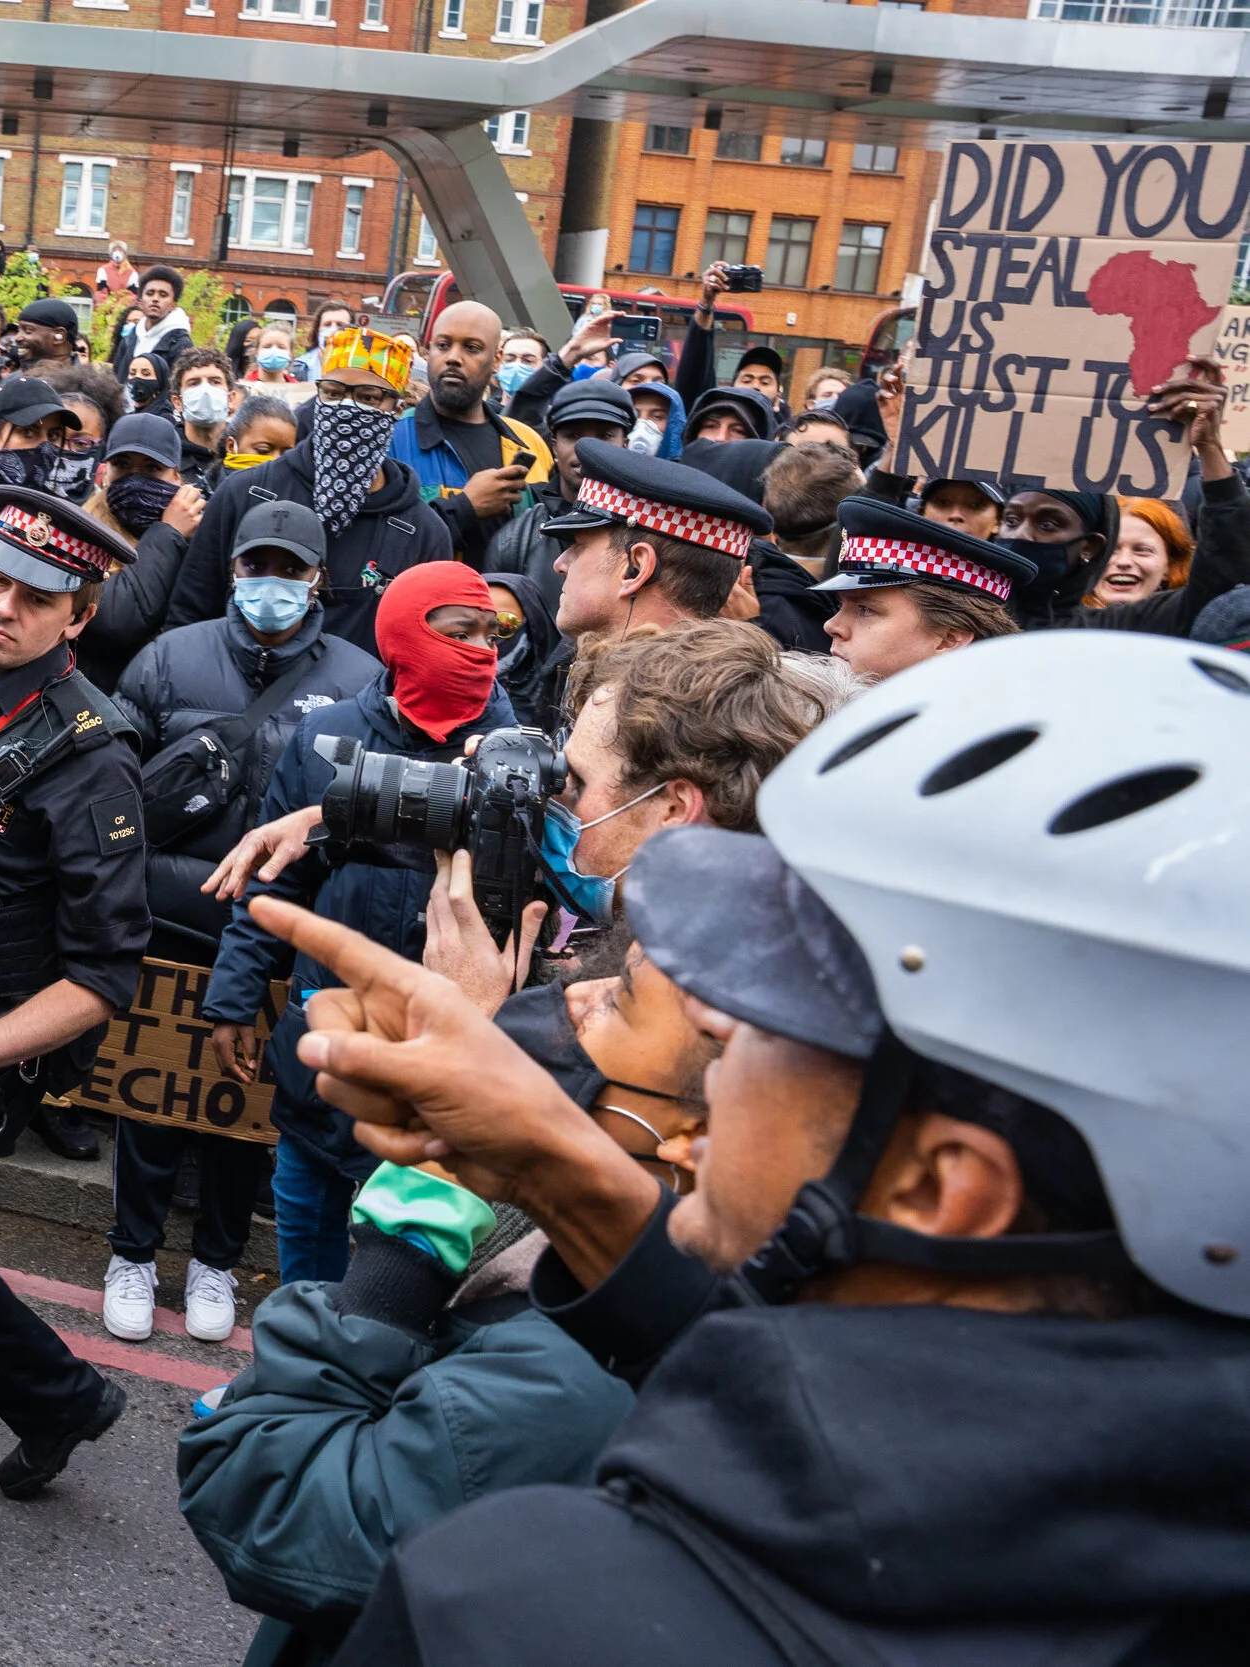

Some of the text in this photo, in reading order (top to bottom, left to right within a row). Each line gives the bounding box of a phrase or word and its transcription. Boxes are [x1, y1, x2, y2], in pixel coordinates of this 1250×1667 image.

[939, 142, 1250, 240] DID YOU
[923, 230, 1093, 308] STEAL
[918, 300, 1004, 353] US
[905, 350, 1070, 413] JUST
[894, 400, 1185, 499] KILL US
[76, 710, 90, 722] CP
[108, 826, 136, 841] 1012SC
[114, 815, 126, 825] CP
[80, 1057, 262, 1130] ECHO.
